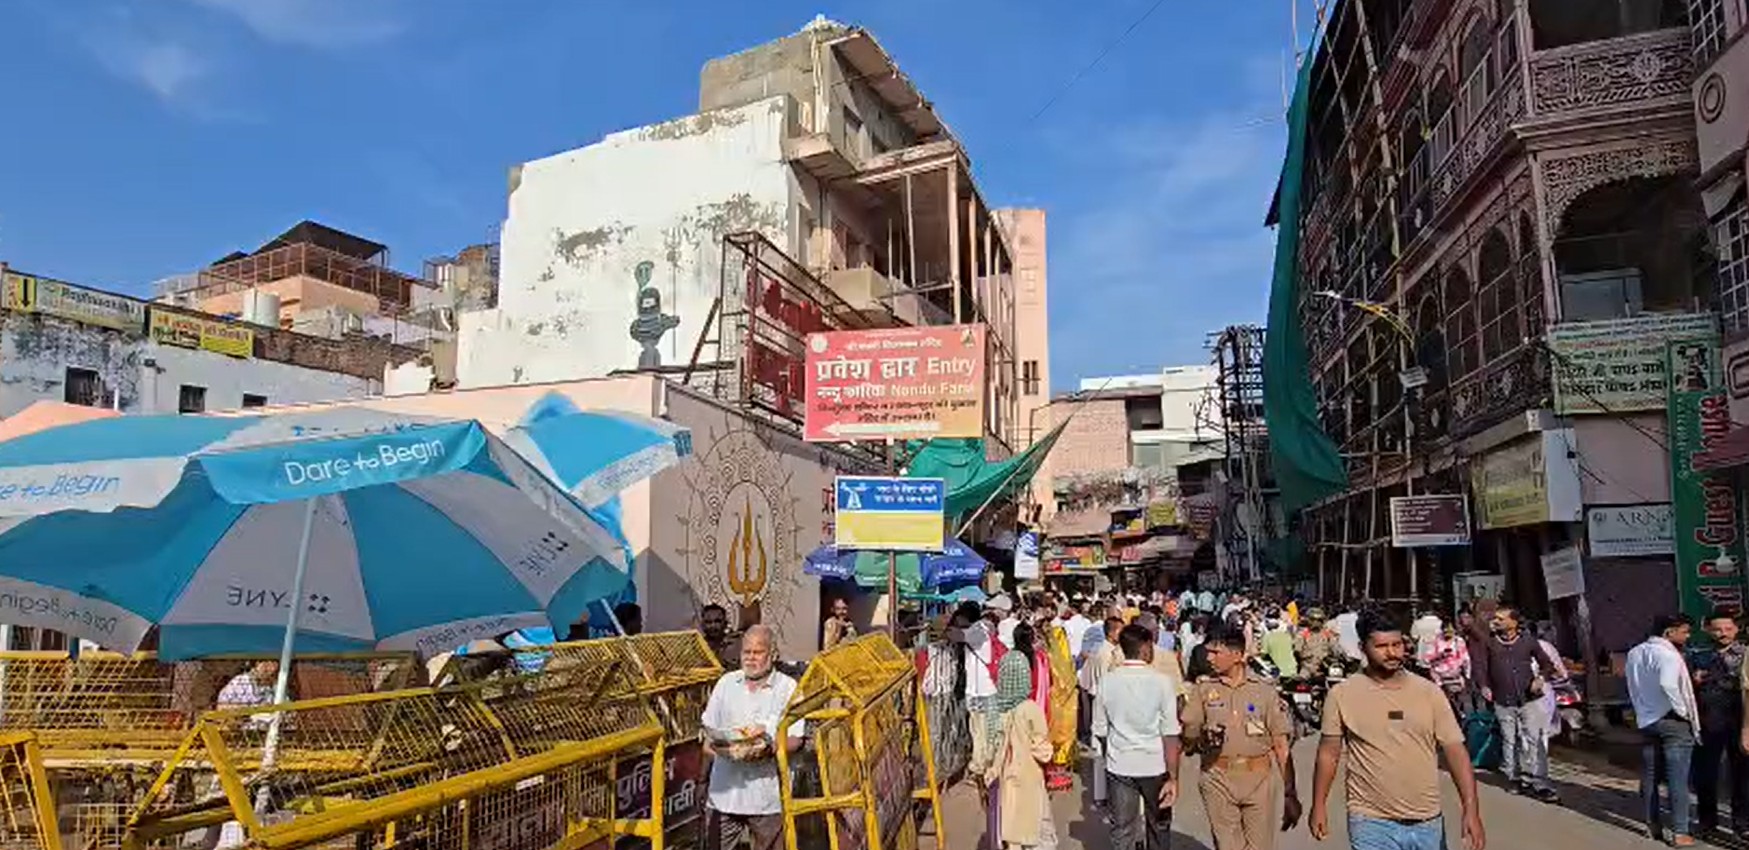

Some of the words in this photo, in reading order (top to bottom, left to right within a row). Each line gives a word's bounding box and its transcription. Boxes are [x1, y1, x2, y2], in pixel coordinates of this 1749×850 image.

[816, 355, 872, 381] प्रवेश
[878, 357, 919, 380] द्वार
[927, 357, 977, 376] Entry
[285, 456, 351, 485] Dare
[353, 452, 379, 471] to
[379, 439, 446, 466] Begin
[48, 474, 120, 498] Begin
[1694, 476, 1738, 546] Guest
